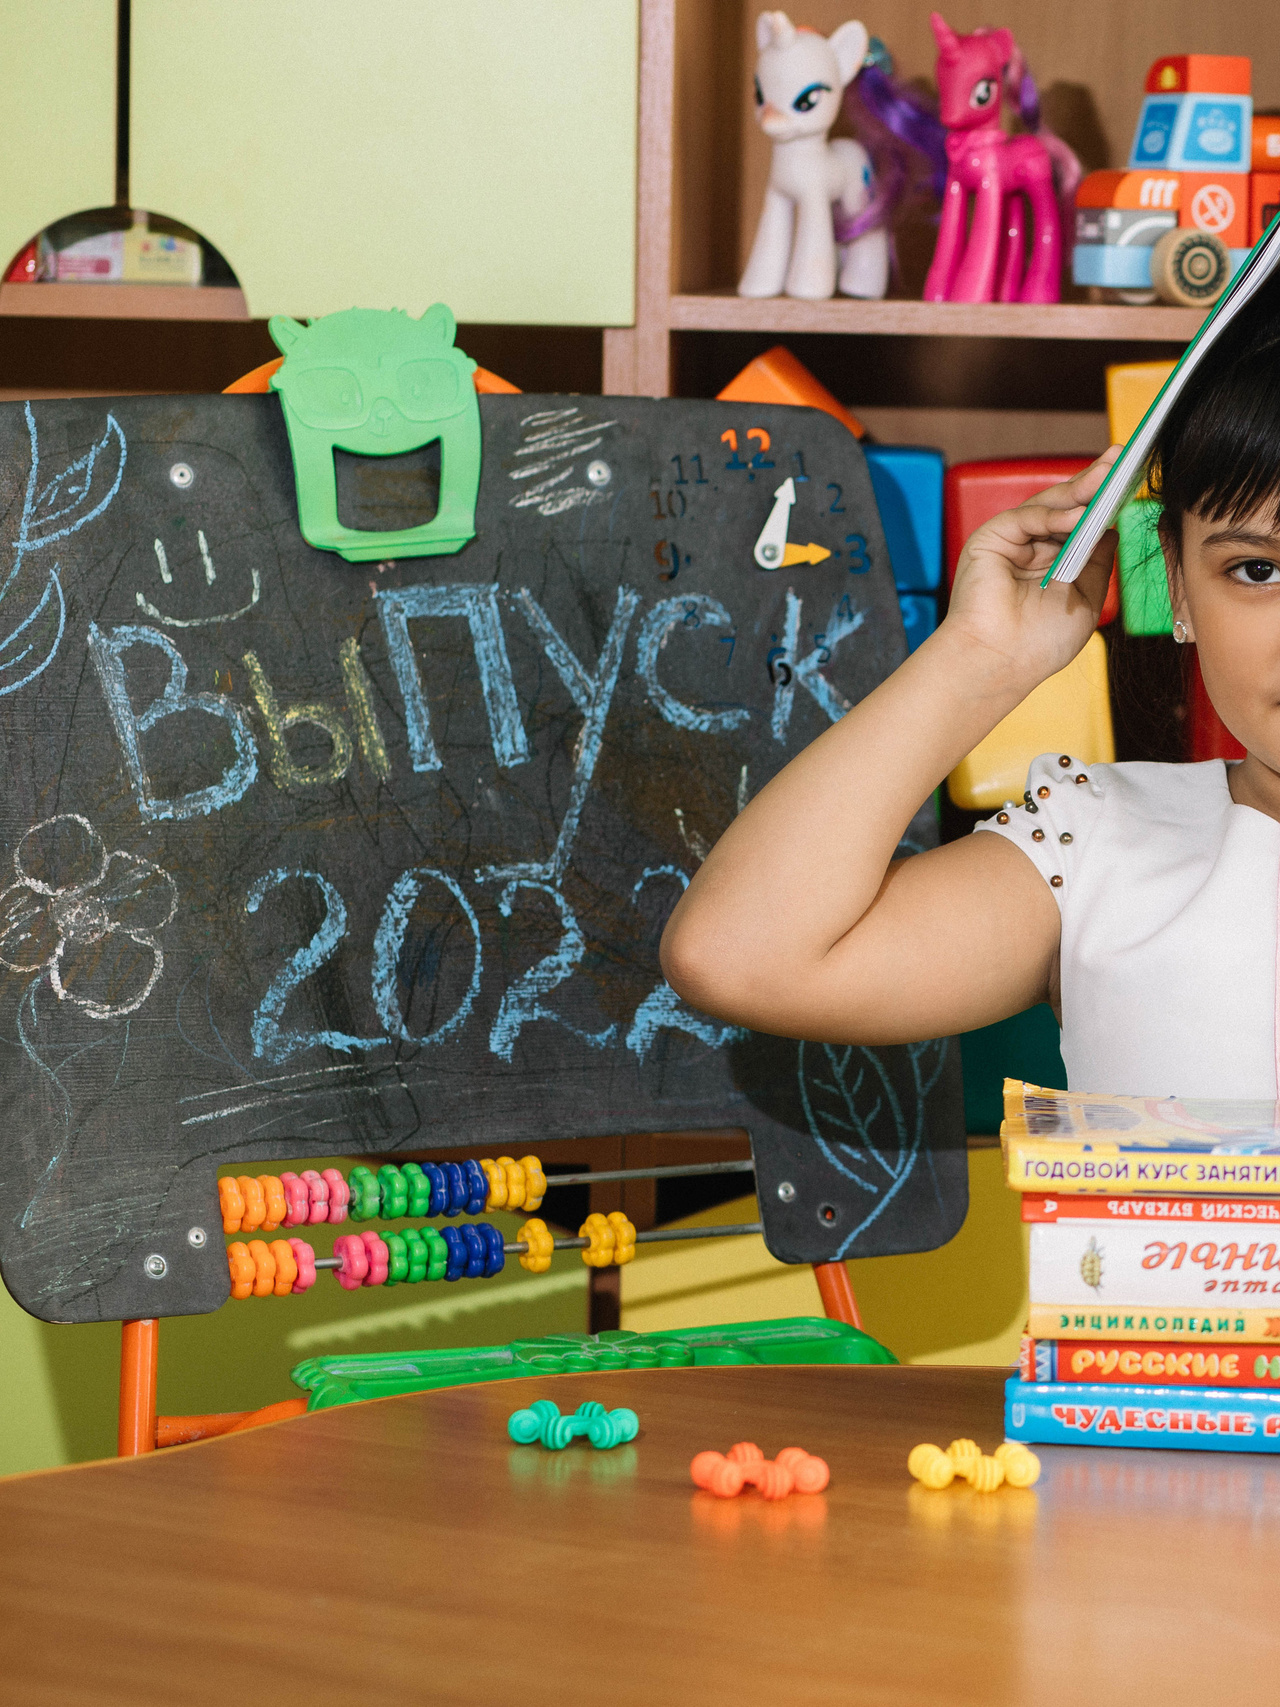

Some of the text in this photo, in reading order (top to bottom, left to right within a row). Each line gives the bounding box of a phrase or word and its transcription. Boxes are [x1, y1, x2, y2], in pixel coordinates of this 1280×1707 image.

[720, 427, 775, 470] 12
[671, 454, 709, 485] 11
[794, 451, 810, 482] 1
[650, 489, 688, 520] 10
[826, 483, 846, 513] 2
[653, 539, 681, 581] 9
[845, 534, 872, 575] 3
[719, 637, 736, 667] 7
[813, 634, 832, 664] 5
[1024, 1158, 1130, 1181] ГОДОВОЙ
[1137, 1162, 1189, 1181] КУРС
[1107, 1199, 1194, 1218] БУКВАРЬ
[1059, 1314, 1246, 1334] ЭНЦИКЛОПЕДИЯ
[1070, 1348, 1241, 1379] РУССКИЕ
[1051, 1403, 1256, 1434] ЧУДЕСНЫЕ
